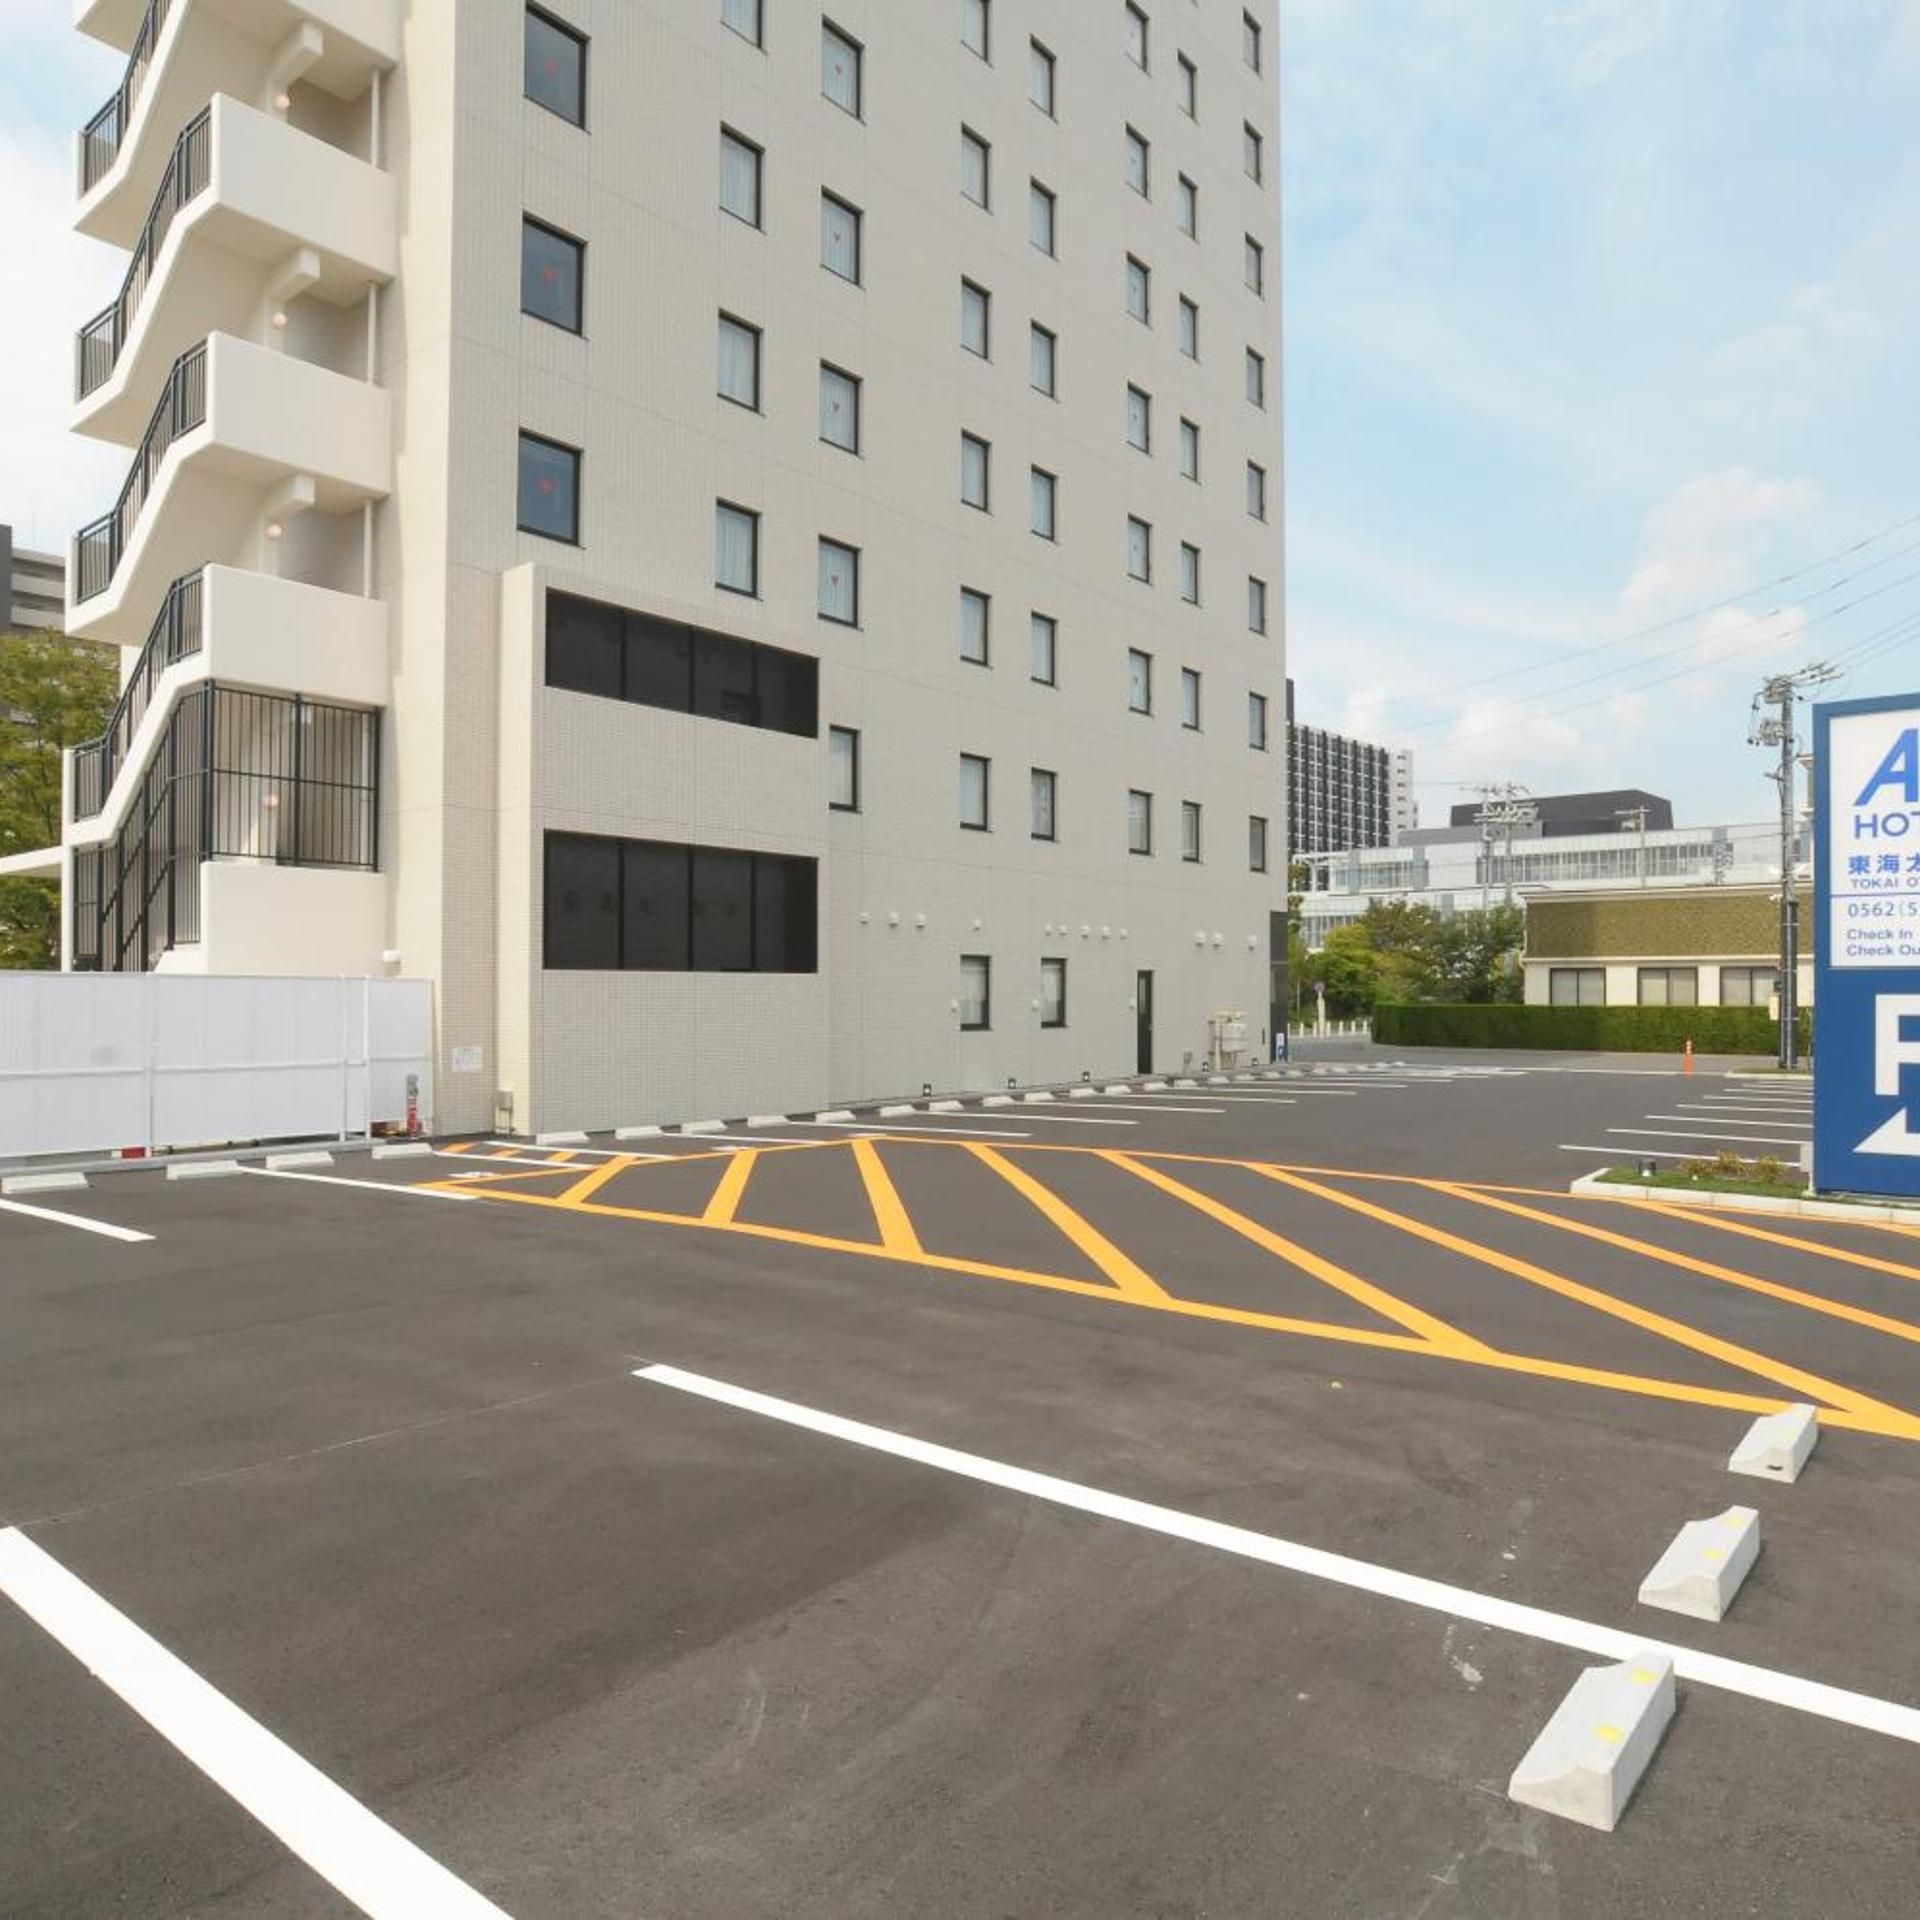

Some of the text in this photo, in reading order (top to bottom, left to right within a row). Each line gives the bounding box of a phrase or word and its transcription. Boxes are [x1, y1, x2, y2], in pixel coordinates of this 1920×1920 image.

[1850, 876, 1920, 889] TOKAI O
[1847, 928, 1913, 940] Check In
[1846, 944, 1894, 956] Check
